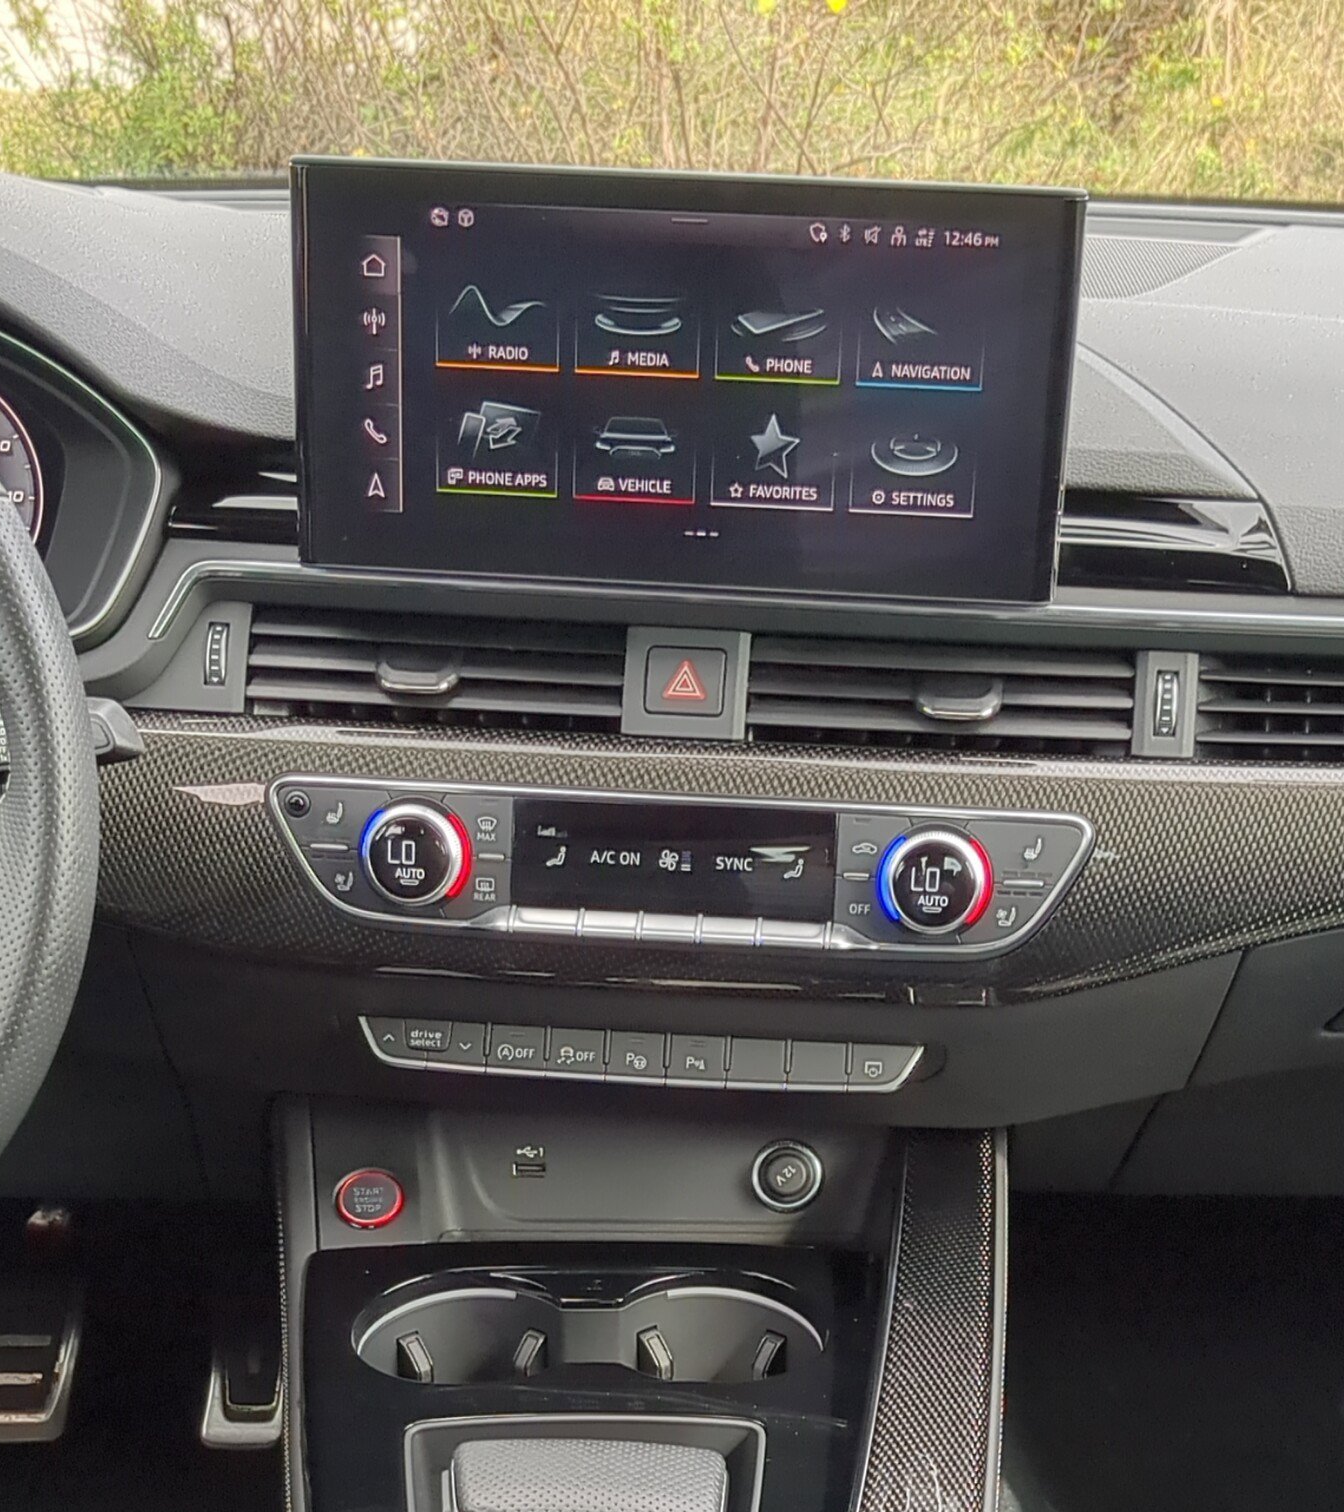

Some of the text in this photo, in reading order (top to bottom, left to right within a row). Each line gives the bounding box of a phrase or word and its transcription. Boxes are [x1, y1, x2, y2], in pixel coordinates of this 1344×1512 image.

[944, 231, 999, 247] 12:46 PM
[488, 345, 528, 360] RADIO
[627, 351, 669, 367] MEDIA
[766, 359, 812, 374] PHONE
[891, 364, 971, 380] NAVIGATION
[468, 470, 547, 488] PHONE APPS
[618, 479, 671, 494] VEHICLE
[749, 485, 817, 501] FAVORITES
[891, 491, 954, 508] SETTINGS
[476, 831, 497, 842] MAX
[387, 840, 415, 866] LO
[590, 850, 641, 866] A/C ON
[715, 856, 753, 872] SYNC
[395, 868, 425, 880] AUTO
[910, 867, 940, 893] LO
[473, 893, 496, 902] REAR
[917, 895, 949, 908] AUTO
[849, 903, 871, 916] OFF
[410, 1029, 442, 1040] drive
[410, 1038, 442, 1048] select
[515, 1048, 535, 1059] OFF
[576, 1051, 596, 1063] OFF
